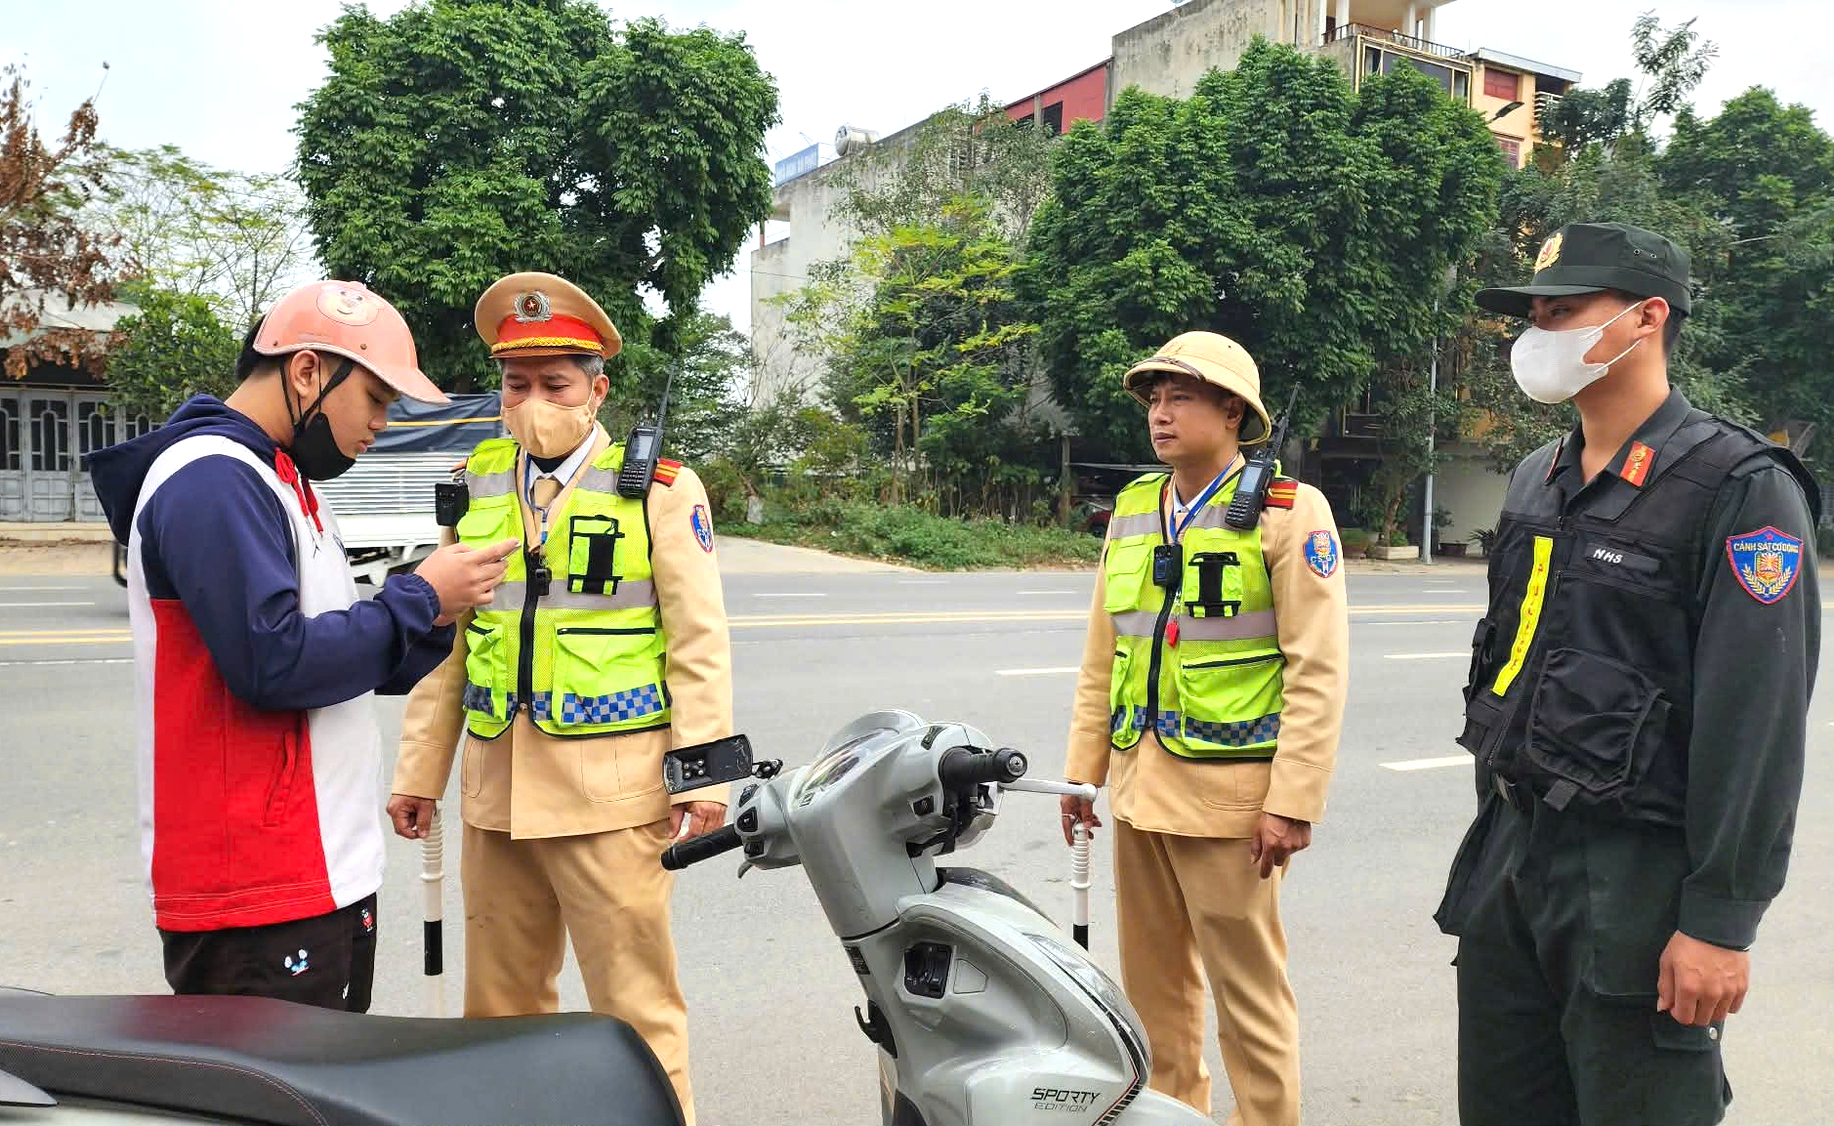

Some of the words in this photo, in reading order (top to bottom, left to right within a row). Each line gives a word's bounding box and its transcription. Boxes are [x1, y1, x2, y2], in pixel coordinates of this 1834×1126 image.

[1593, 548, 1623, 563] NHS
[1030, 1088, 1101, 1104] SPORTY
[1034, 1102, 1088, 1112] EDITION
